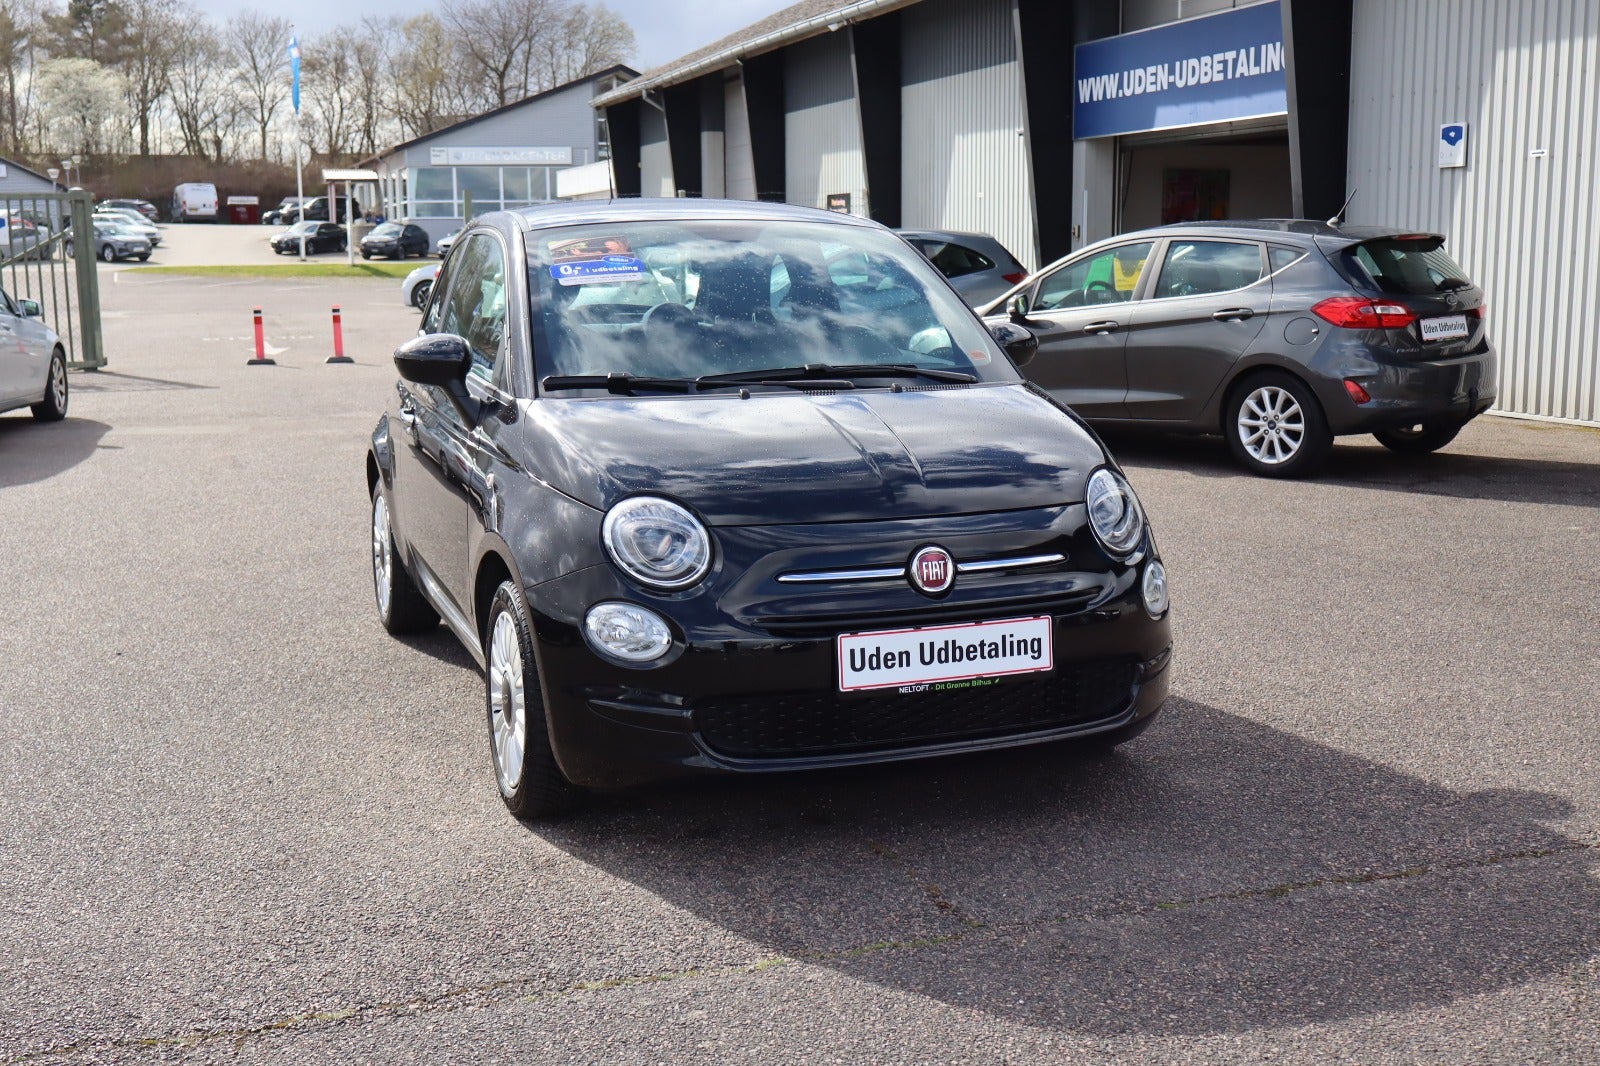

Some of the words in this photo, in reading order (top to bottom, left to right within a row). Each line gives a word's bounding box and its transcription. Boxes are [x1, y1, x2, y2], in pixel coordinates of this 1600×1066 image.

[1078, 41, 1286, 104] WWW.UDEN-UDBETALIN
[592, 265, 639, 273] udbetaling
[1423, 324, 1439, 334] Uden
[1439, 321, 1466, 333] Udbetaling
[922, 560, 945, 582] FIAT
[849, 646, 911, 673] Uden
[919, 633, 1042, 666] Udbetaling
[899, 684, 929, 694] NELTOFT
[935, 682, 945, 691] Dit
[971, 679, 992, 687] Bilhus
